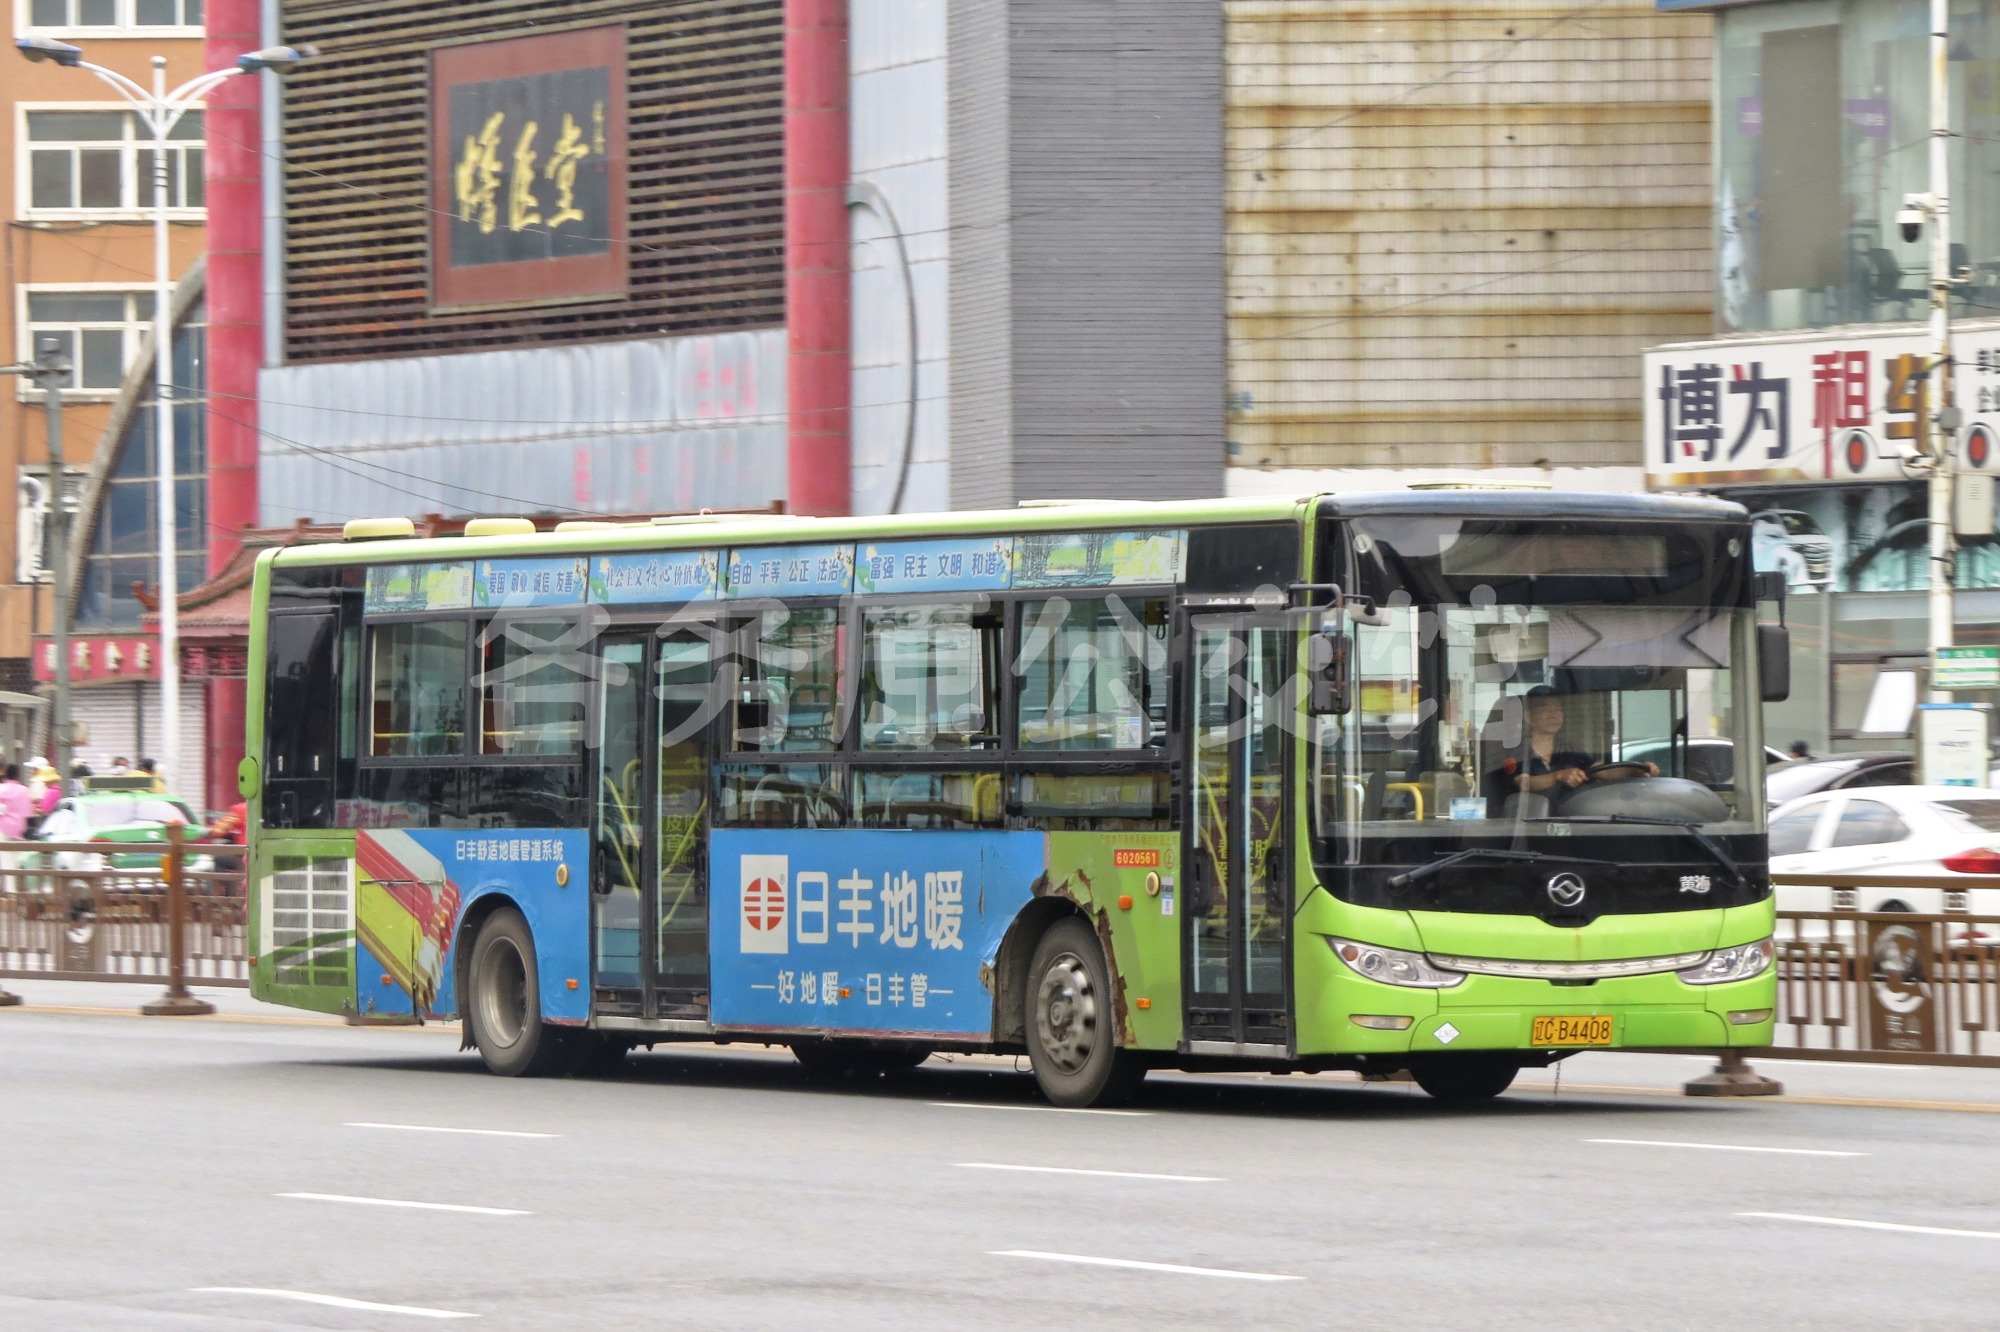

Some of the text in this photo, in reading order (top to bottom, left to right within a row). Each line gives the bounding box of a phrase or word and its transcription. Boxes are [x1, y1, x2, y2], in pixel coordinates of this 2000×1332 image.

[606, 560, 703, 590] 社会主义核心价值观
[732, 557, 839, 585] 自由 平等 公正 法治
[870, 550, 997, 579] 富强 民主 文明 和谐
[489, 572, 506, 594] 爱国
[556, 570, 574, 593] 友善
[456, 839, 564, 861] 日丰舒适地暖管道系统
[1116, 851, 1157, 864] 6020561
[796, 868, 963, 950] 日丰地暖
